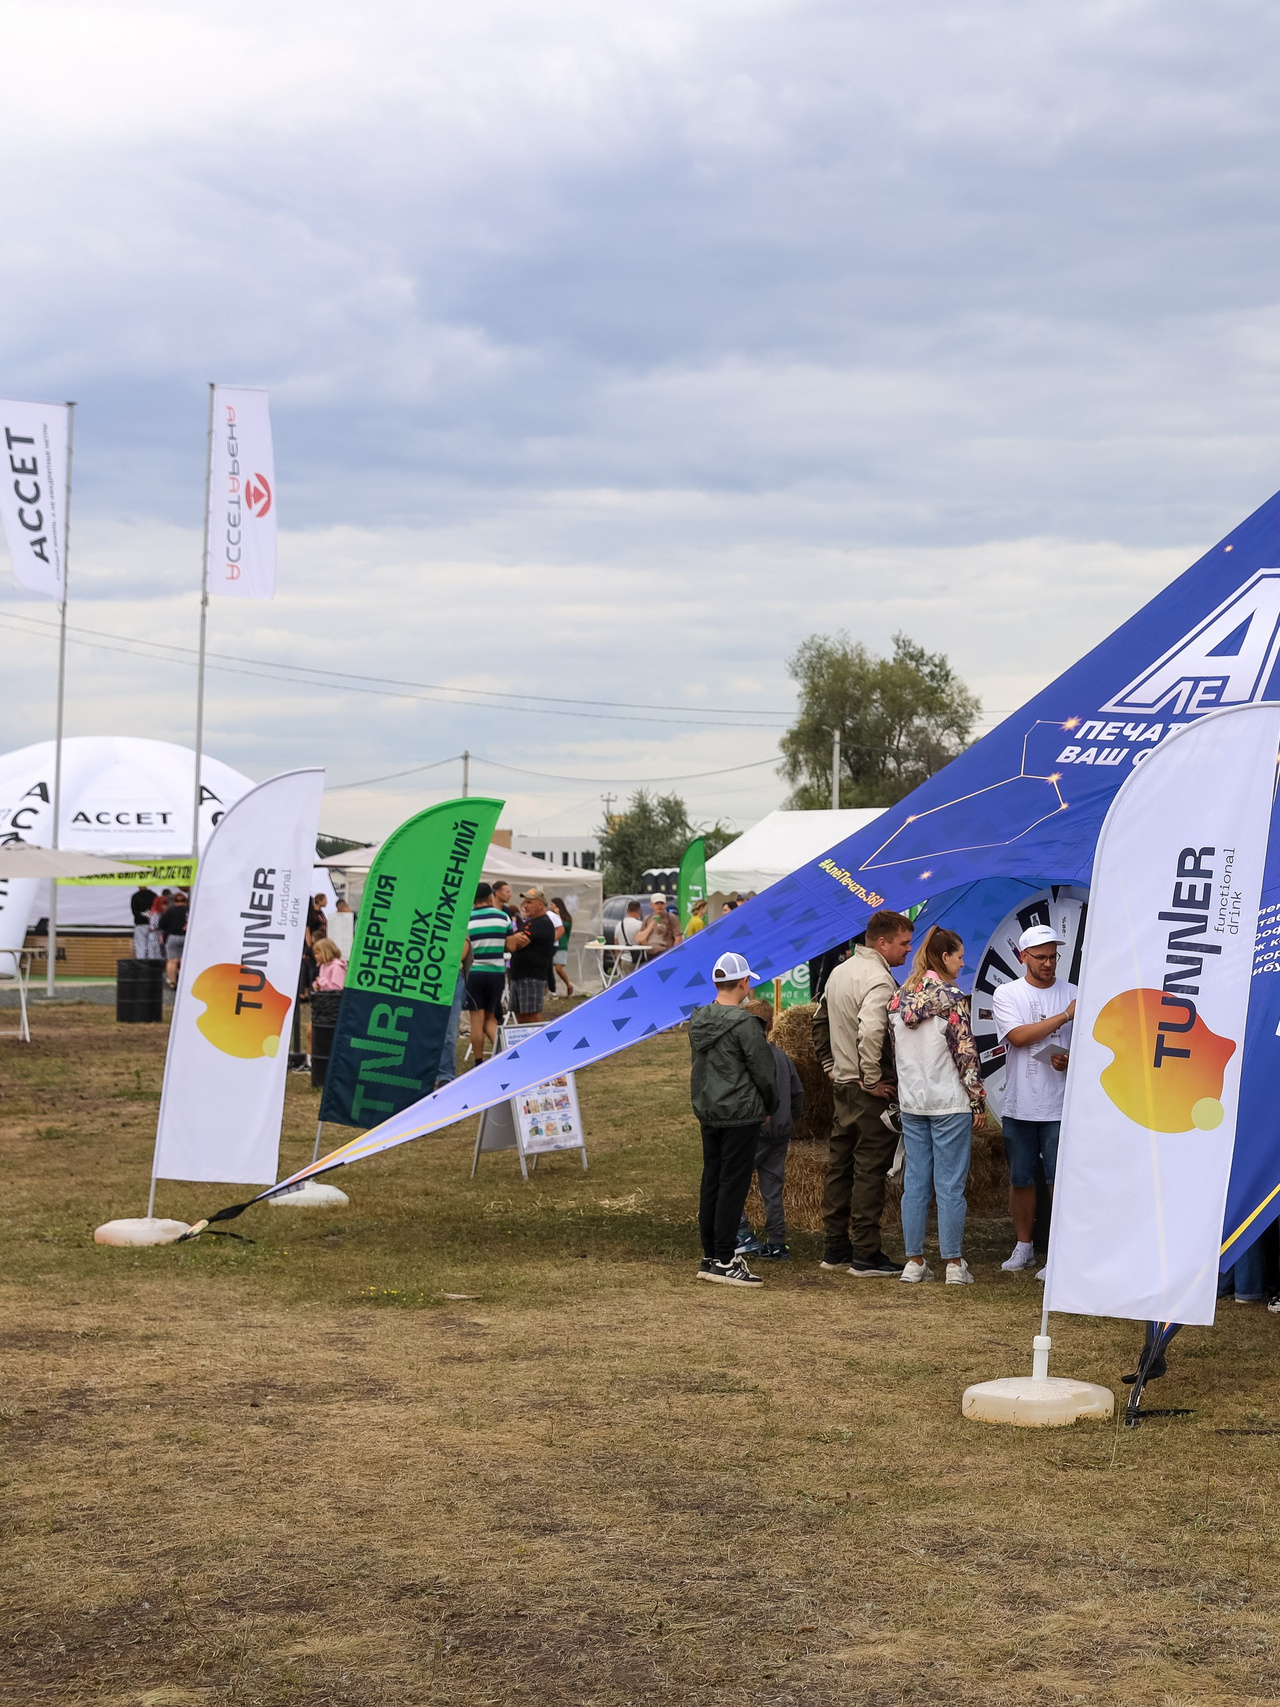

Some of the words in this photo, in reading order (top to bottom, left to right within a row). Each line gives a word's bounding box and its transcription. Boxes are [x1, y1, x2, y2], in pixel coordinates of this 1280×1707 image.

[1055, 745, 1130, 766] ВАШ
[1074, 720, 1189, 742] ПЕЧАТ
[71, 811, 173, 826] АССЕТ
[277, 869, 292, 927] functional
[419, 819, 479, 1001] ДОСТИЖЕНИЙ
[818, 858, 885, 908] #АлёПечать360
[1213, 847, 1236, 935] functional
[289, 897, 300, 928] drink
[357, 874, 397, 987] ЭНЕРГИЯ
[1229, 891, 1243, 936] drink
[234, 867, 285, 1016] TUNNER
[378, 940, 404, 994] ДЛЯ
[400, 908, 433, 993] ТВОИХ
[1153, 846, 1222, 1068] TUNNER
[760, 990, 799, 998] ВКУНОЕ
[349, 1003, 422, 1121] TNR
